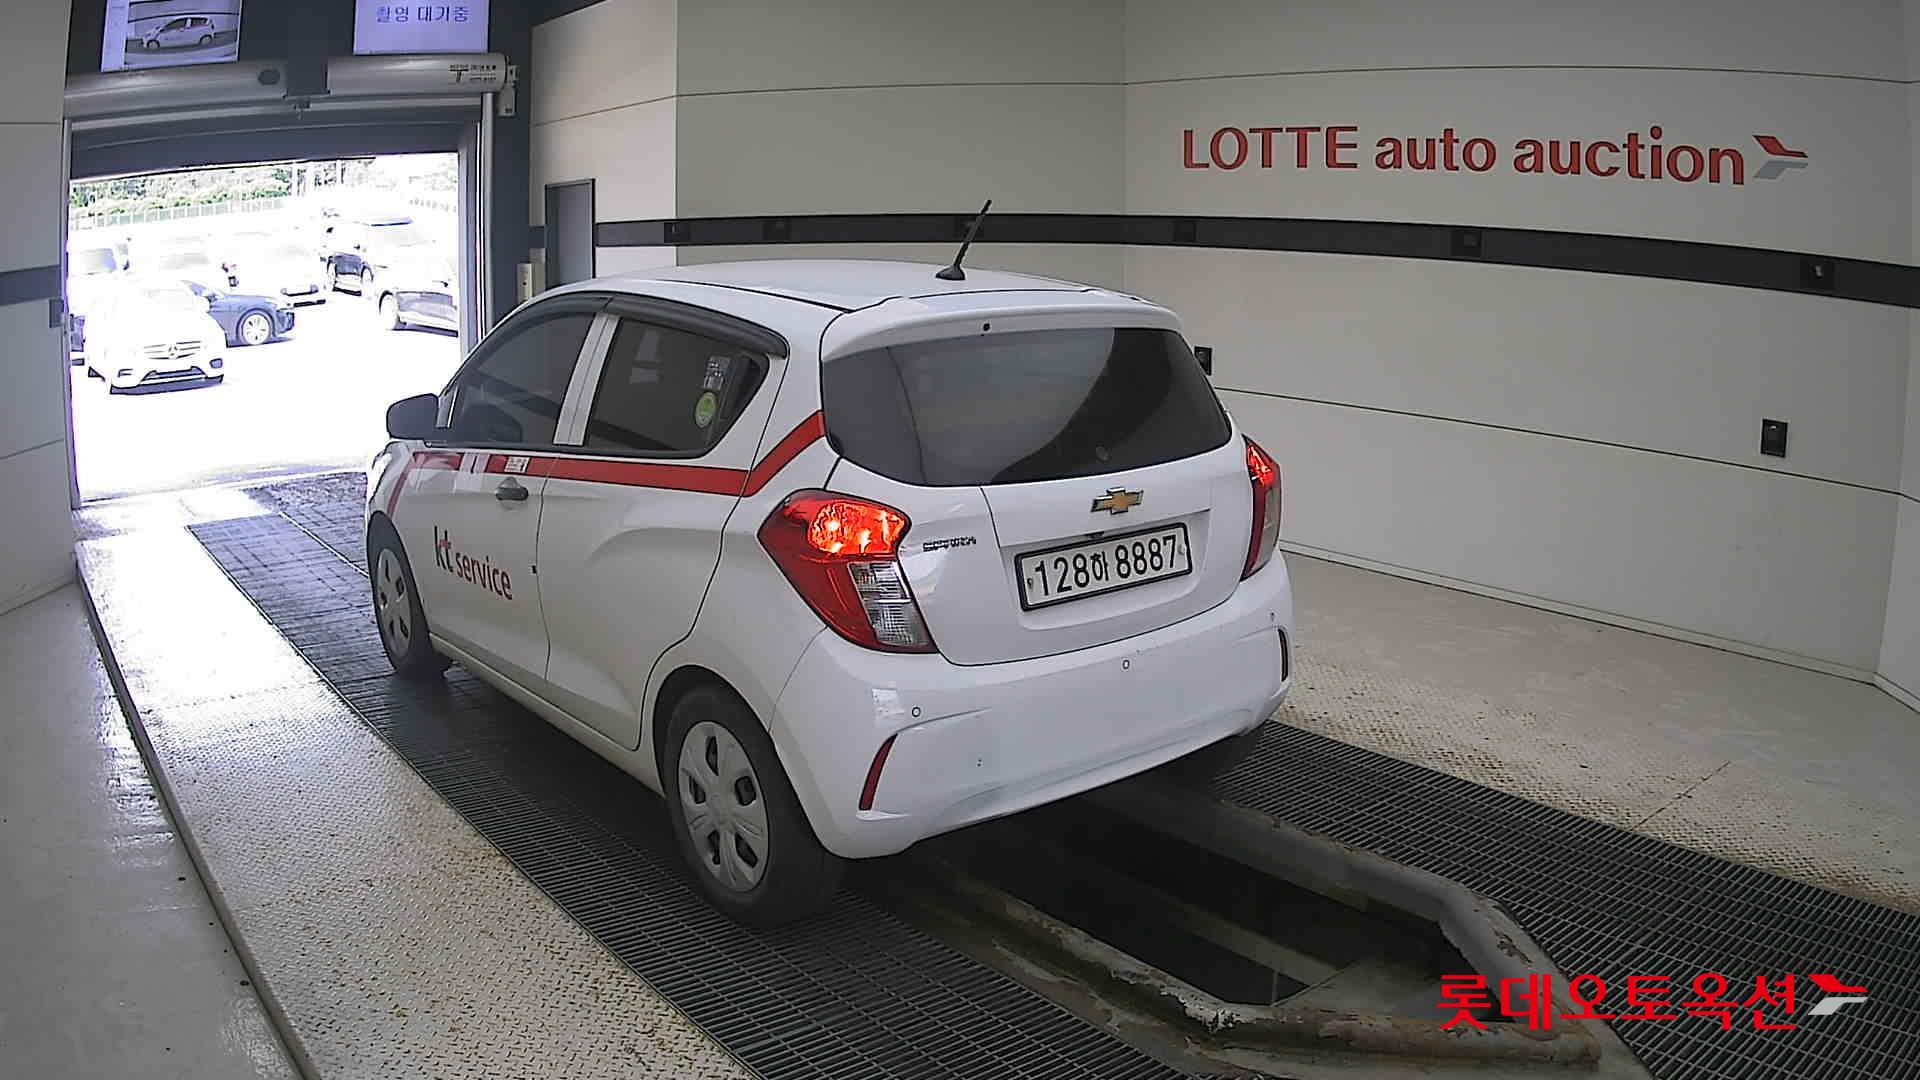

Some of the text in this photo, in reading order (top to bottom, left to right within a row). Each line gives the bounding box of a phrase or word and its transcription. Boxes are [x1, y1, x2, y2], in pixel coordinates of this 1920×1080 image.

[417, 6, 468, 23] 대기중
[1183, 126, 1745, 186] LOTTE auto auction
[434, 525, 513, 600] kt service
[1035, 534, 1176, 596] 128하 8887
